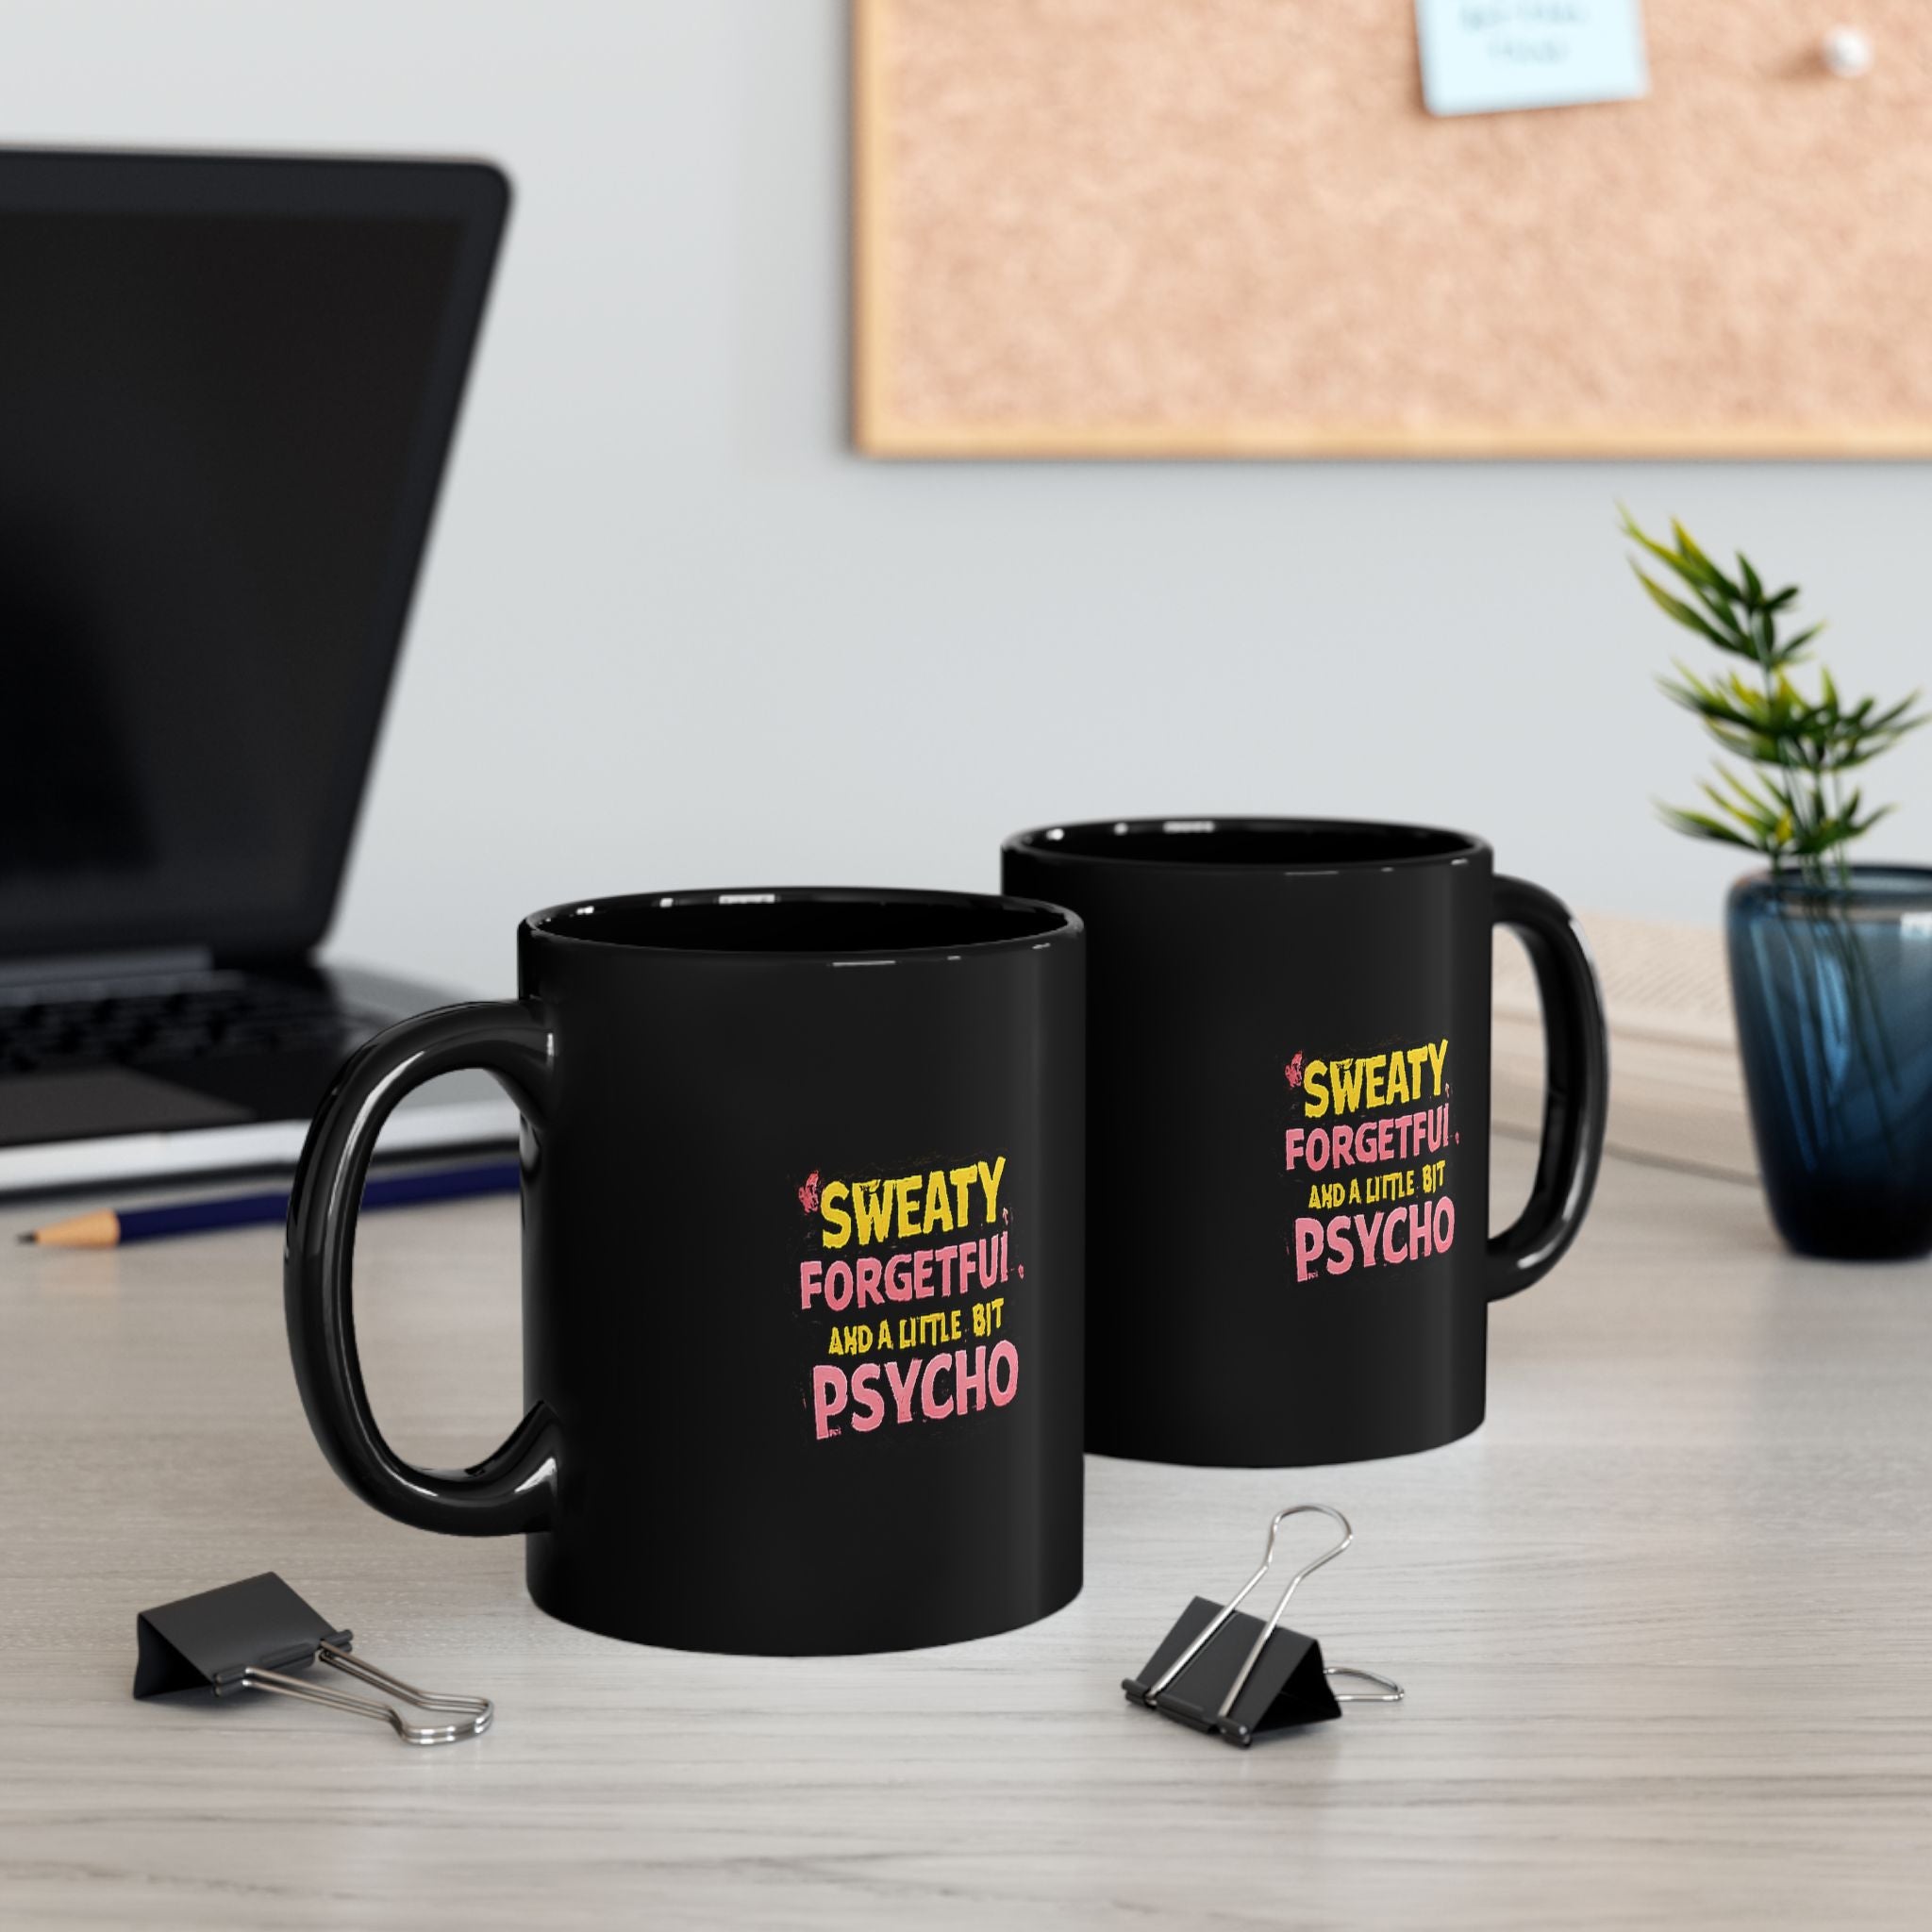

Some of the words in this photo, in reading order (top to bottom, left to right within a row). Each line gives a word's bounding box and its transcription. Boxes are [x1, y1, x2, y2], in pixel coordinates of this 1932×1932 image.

[1348, 1176, 1362, 1205] A
[1366, 1170, 1415, 1204] LITTLE
[1422, 1159, 1446, 1194] BIT
[1294, 1195, 1456, 1283] PSYCHO
[877, 1319, 894, 1351] A
[899, 1309, 962, 1350] LITTLE
[972, 1297, 1005, 1338] BIT
[812, 1339, 1019, 1441] PSYCHO
